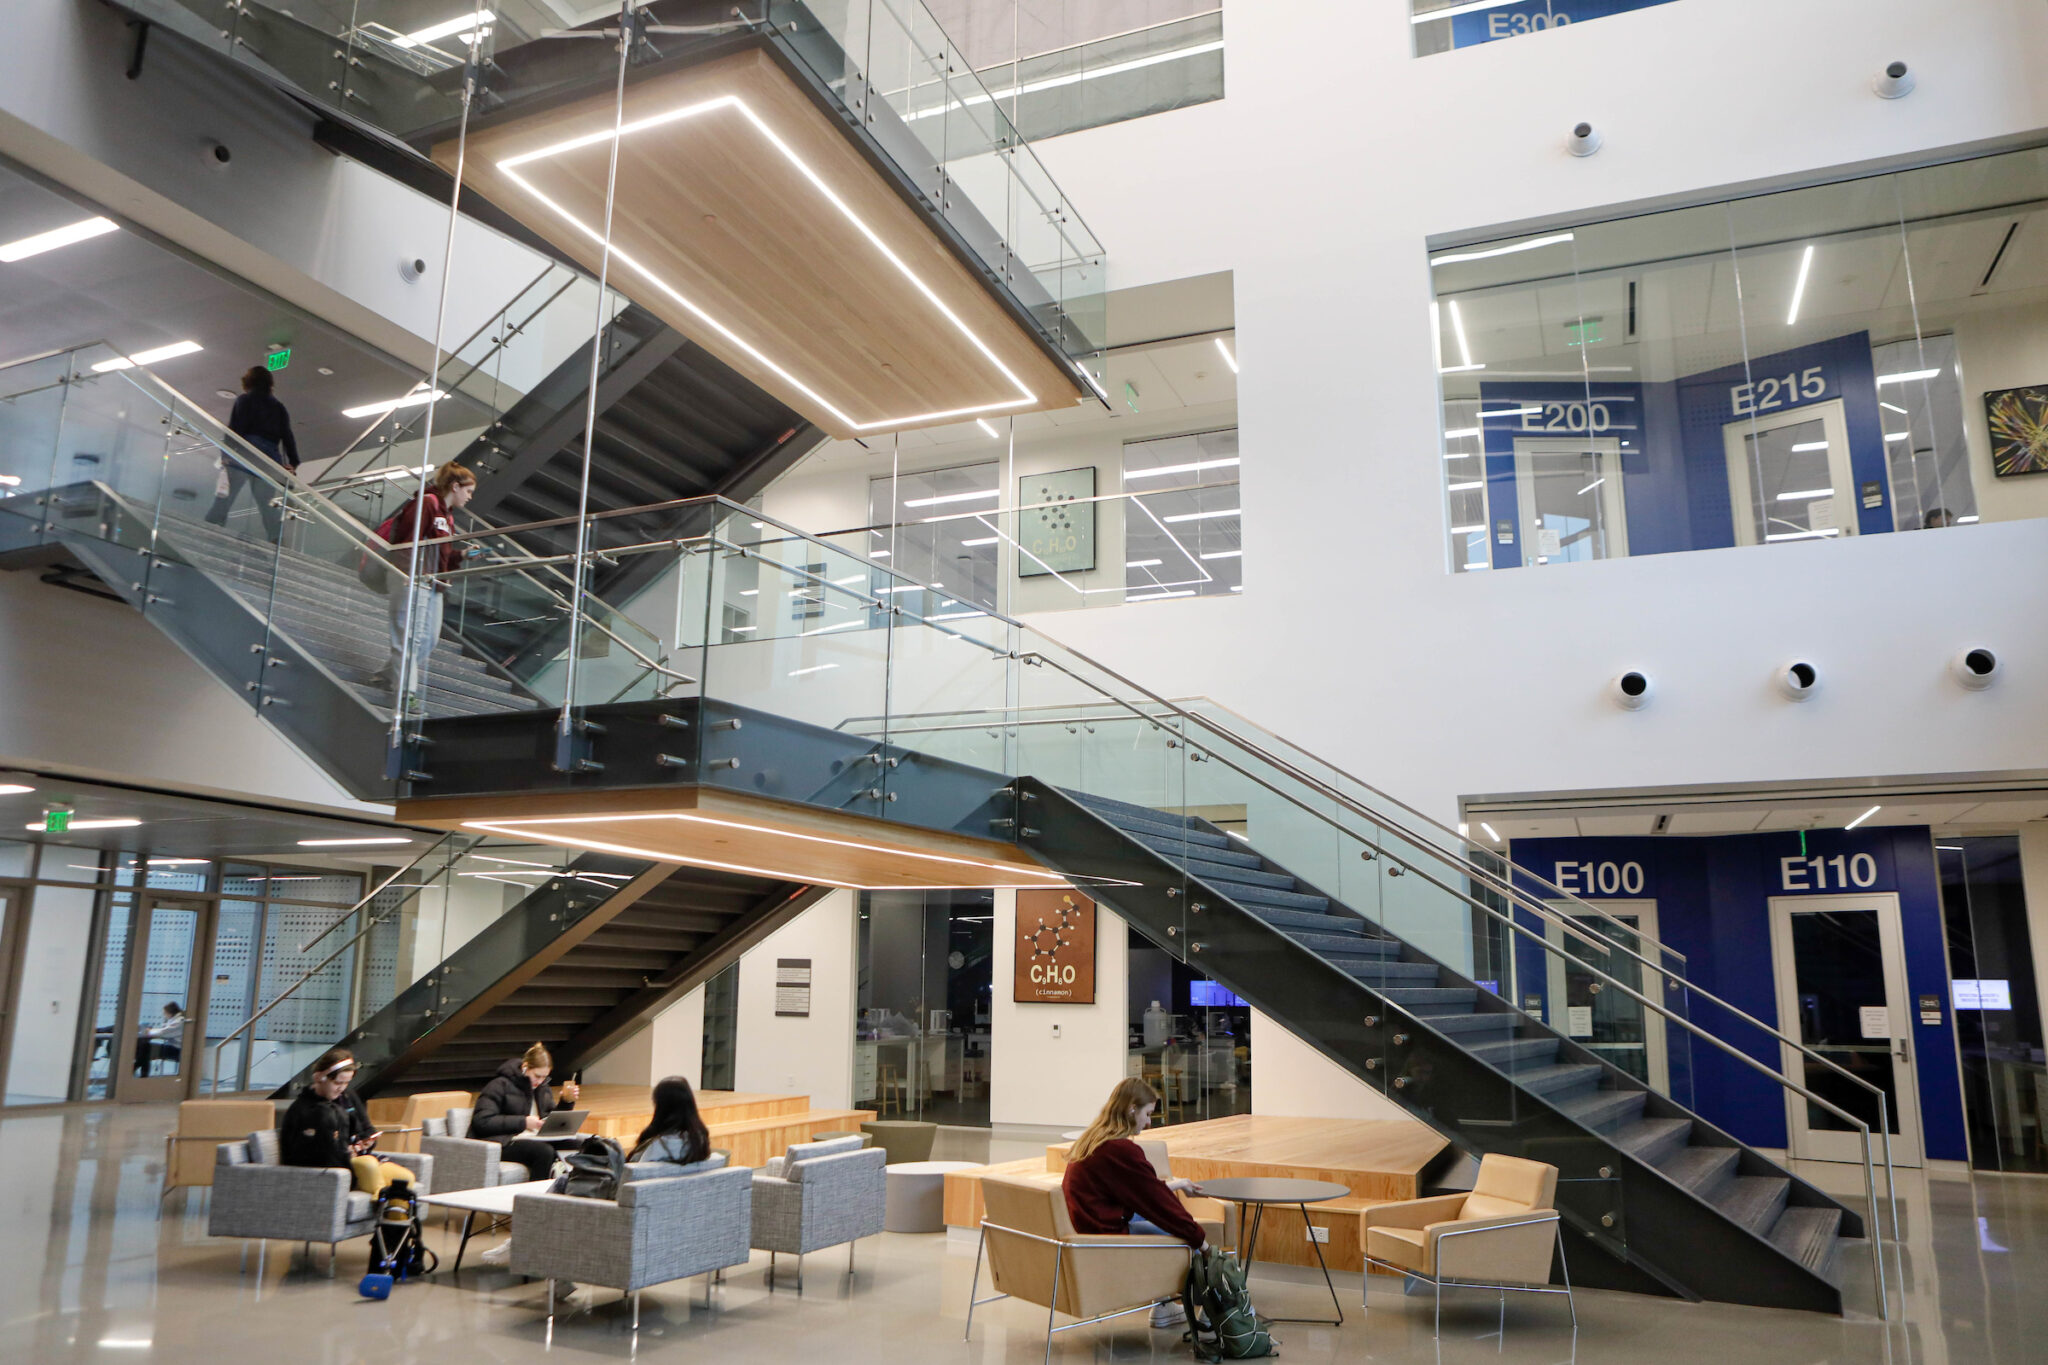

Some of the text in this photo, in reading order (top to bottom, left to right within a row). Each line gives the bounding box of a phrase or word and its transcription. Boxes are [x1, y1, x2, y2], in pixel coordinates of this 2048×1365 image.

[1731, 366, 1826, 416] E215
[1521, 402, 1610, 432] E200
[1555, 861, 1645, 894] E100
[1781, 852, 1877, 890] E110
